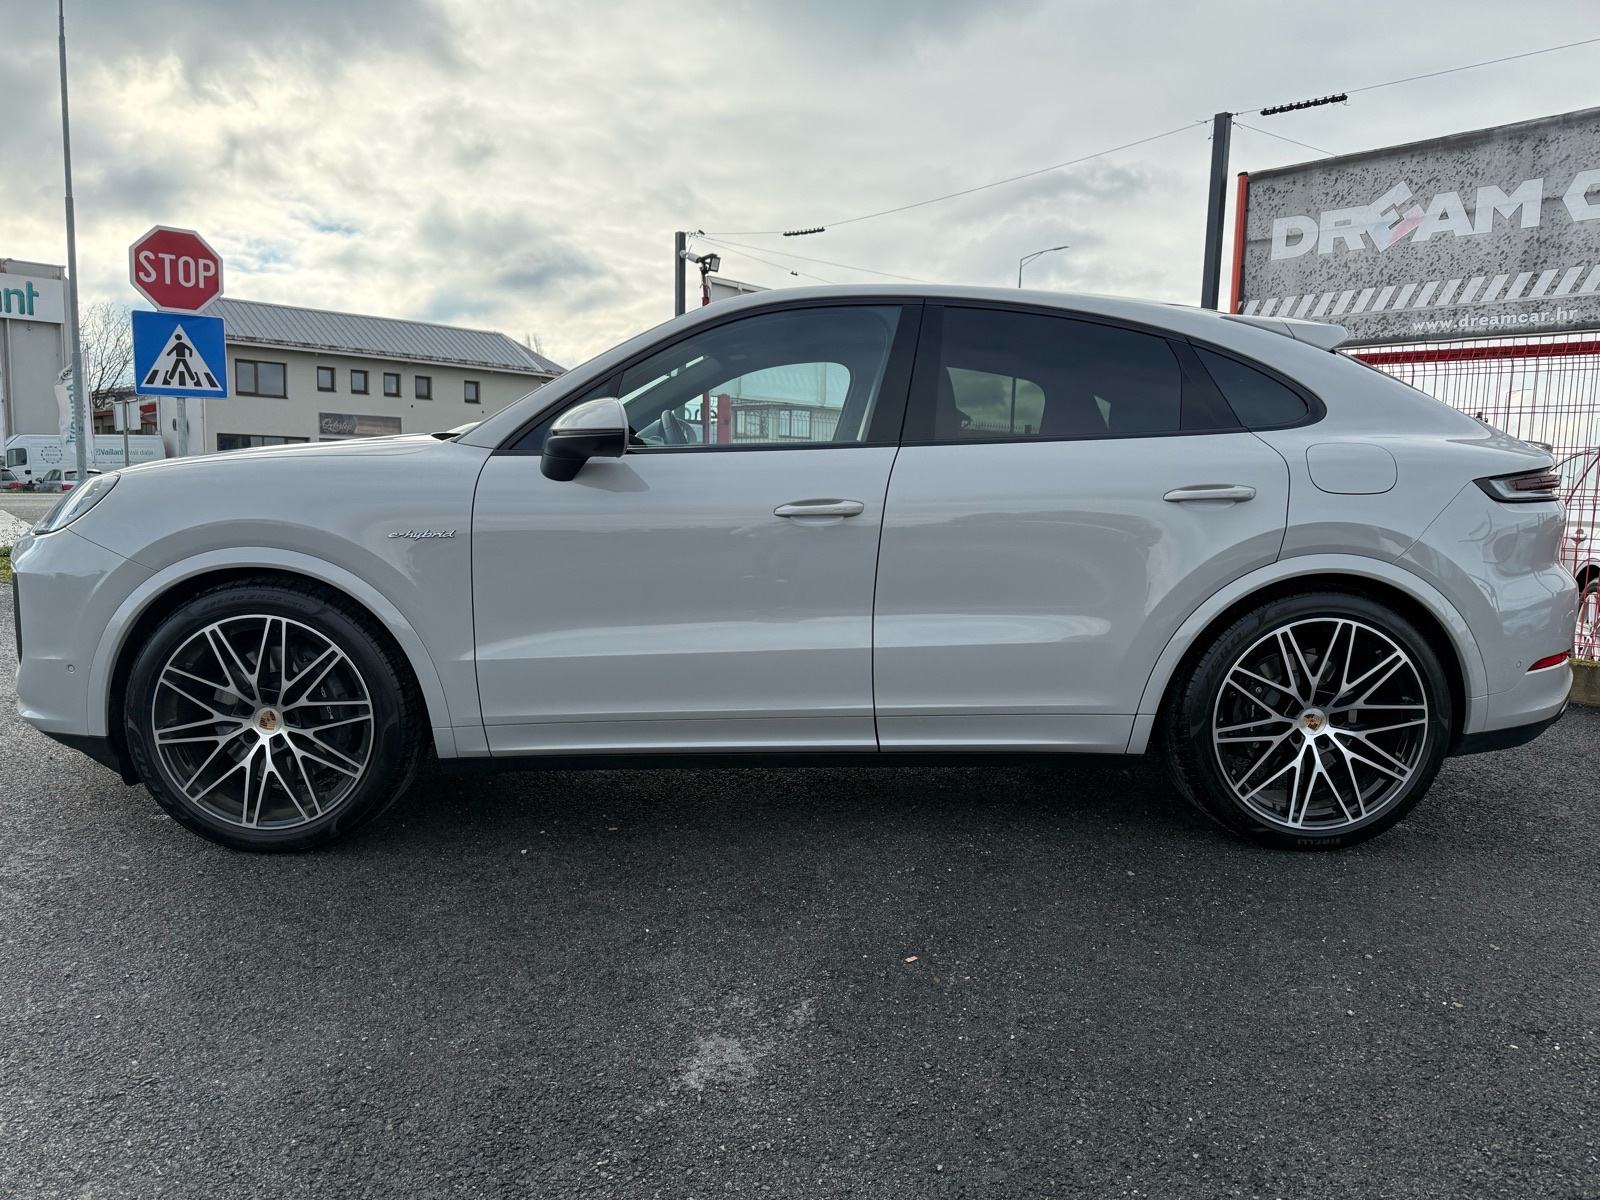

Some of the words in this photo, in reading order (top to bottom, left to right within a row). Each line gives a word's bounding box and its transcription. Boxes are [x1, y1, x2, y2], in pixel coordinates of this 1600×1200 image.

[1271, 180, 1544, 261] DREAM
[138, 250, 216, 289] STOP
[1412, 306, 1578, 332] www.dreamcar.hr
[387, 529, 457, 541] e-hybrid
